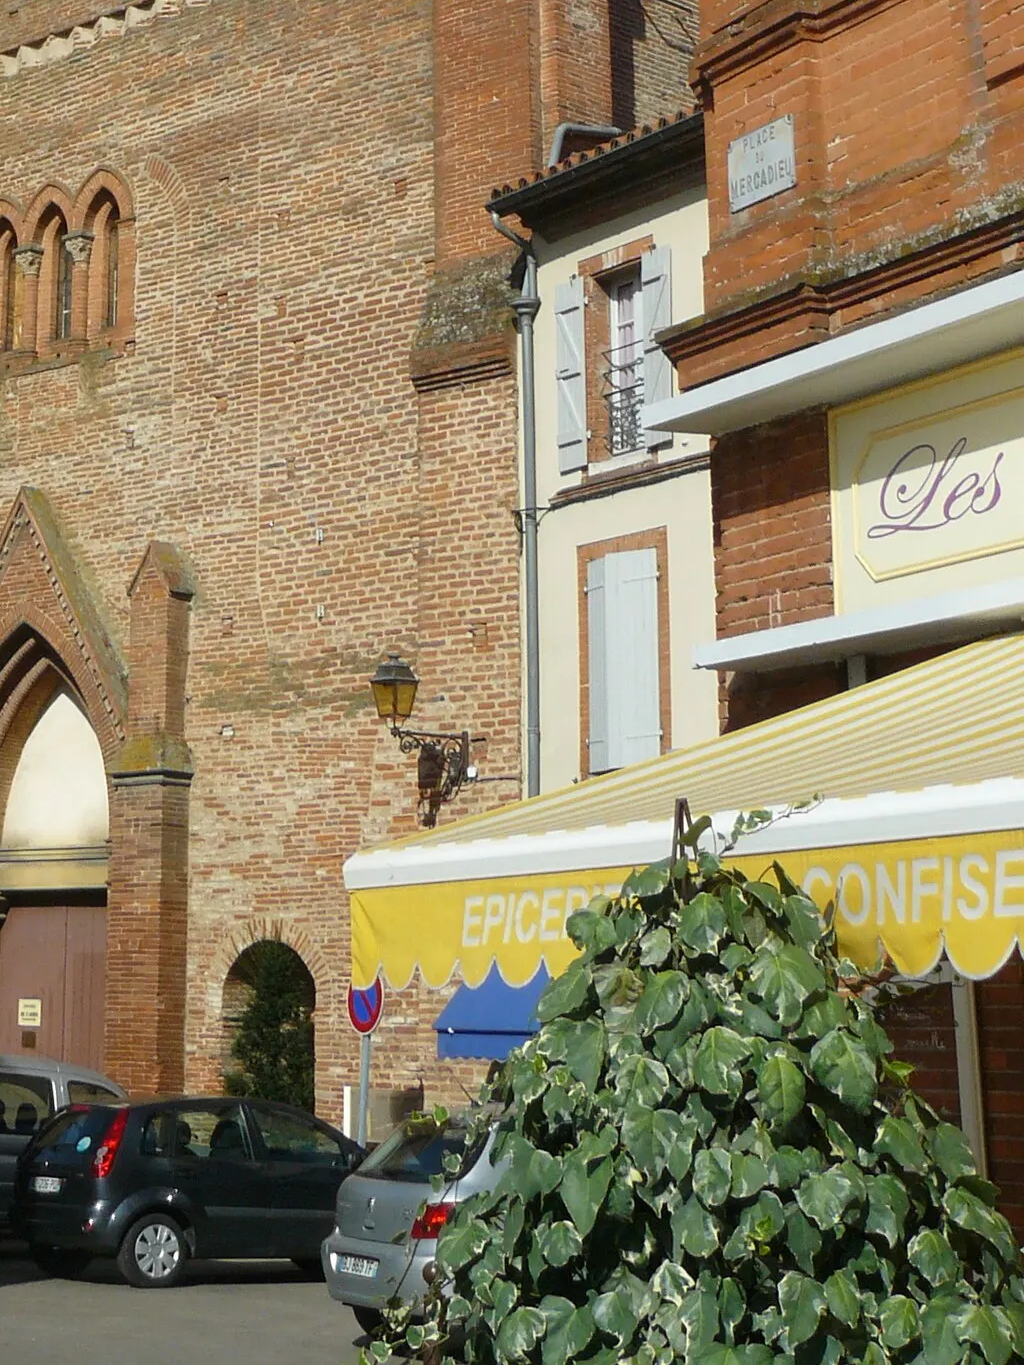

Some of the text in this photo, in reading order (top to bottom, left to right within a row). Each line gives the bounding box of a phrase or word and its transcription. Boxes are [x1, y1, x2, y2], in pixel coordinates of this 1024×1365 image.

[742, 125, 776, 152] PLACE
[730, 157, 792, 200] MERCADIEU
[867, 436, 1004, 539] Les
[461, 882, 624, 948] EPICER
